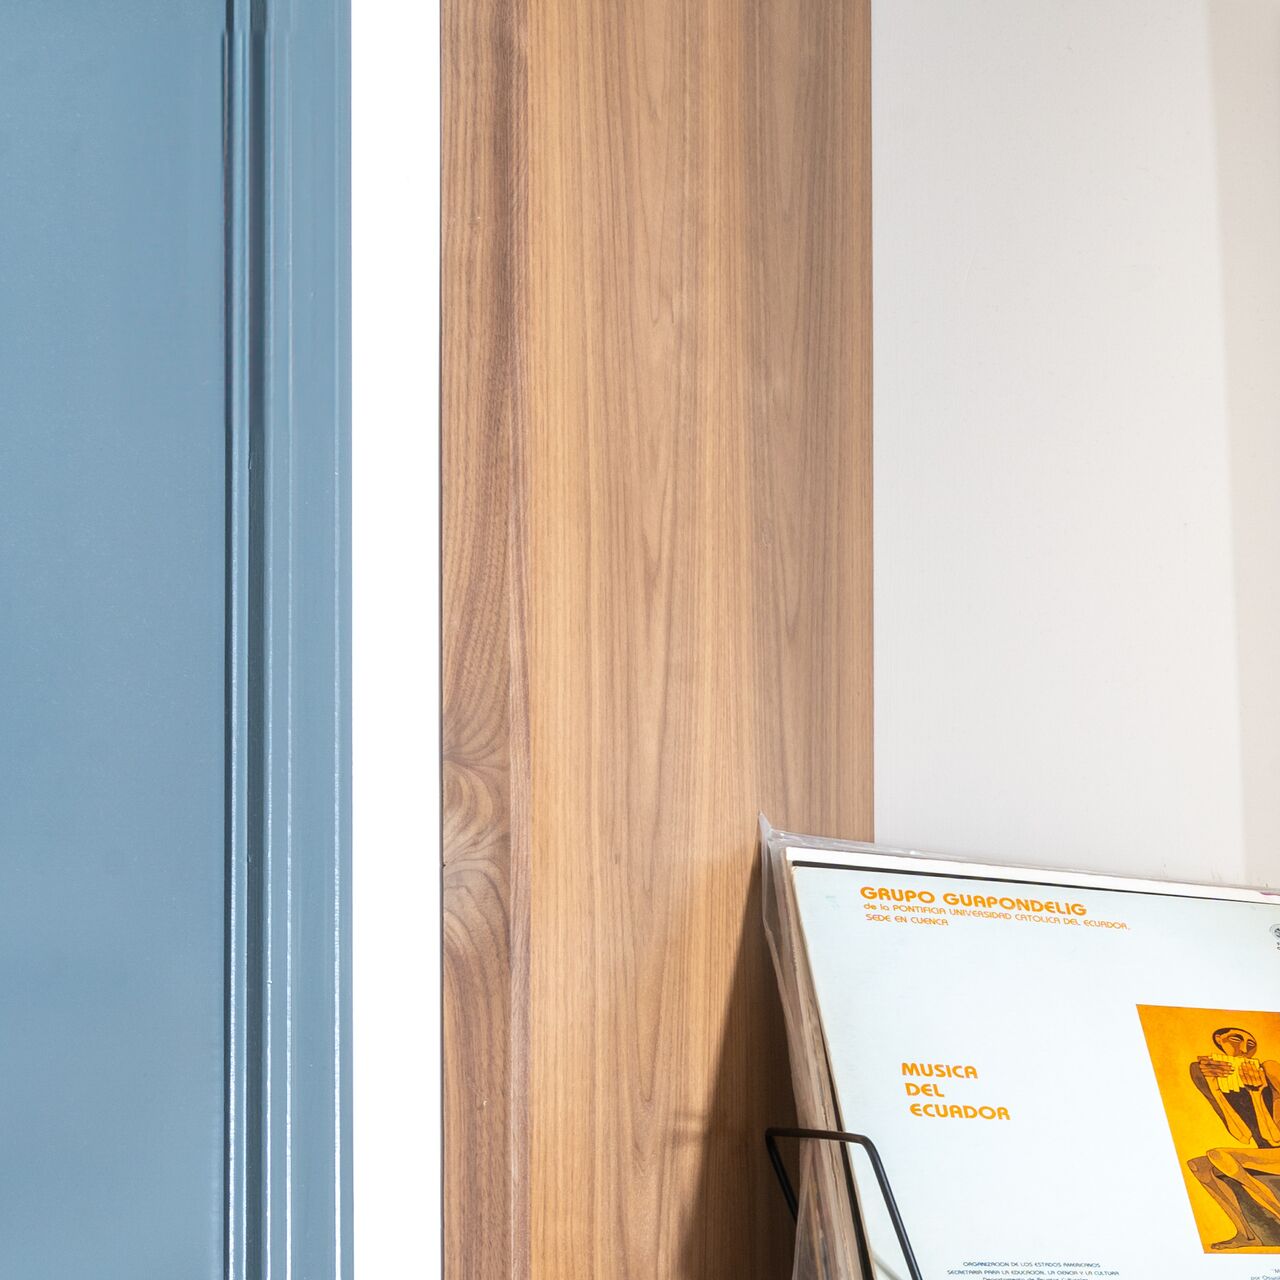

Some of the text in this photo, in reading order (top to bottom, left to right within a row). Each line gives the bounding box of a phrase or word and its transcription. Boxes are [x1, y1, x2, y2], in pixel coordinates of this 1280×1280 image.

[860, 886, 1087, 916] GRUPO GUAPONDELIG
[863, 903, 877, 911] de
[893, 904, 947, 915] PONTIFICIA
[949, 908, 1012, 920] UNIVERSIDAD
[1014, 914, 1061, 924] CATOLICA
[1063, 917, 1079, 925] DEL
[865, 914, 949, 926] SEDE EN CUENCA
[901, 1062, 979, 1079] MUSICA
[905, 1082, 945, 1098] DEL
[910, 1103, 1011, 1120] ECUADOR
